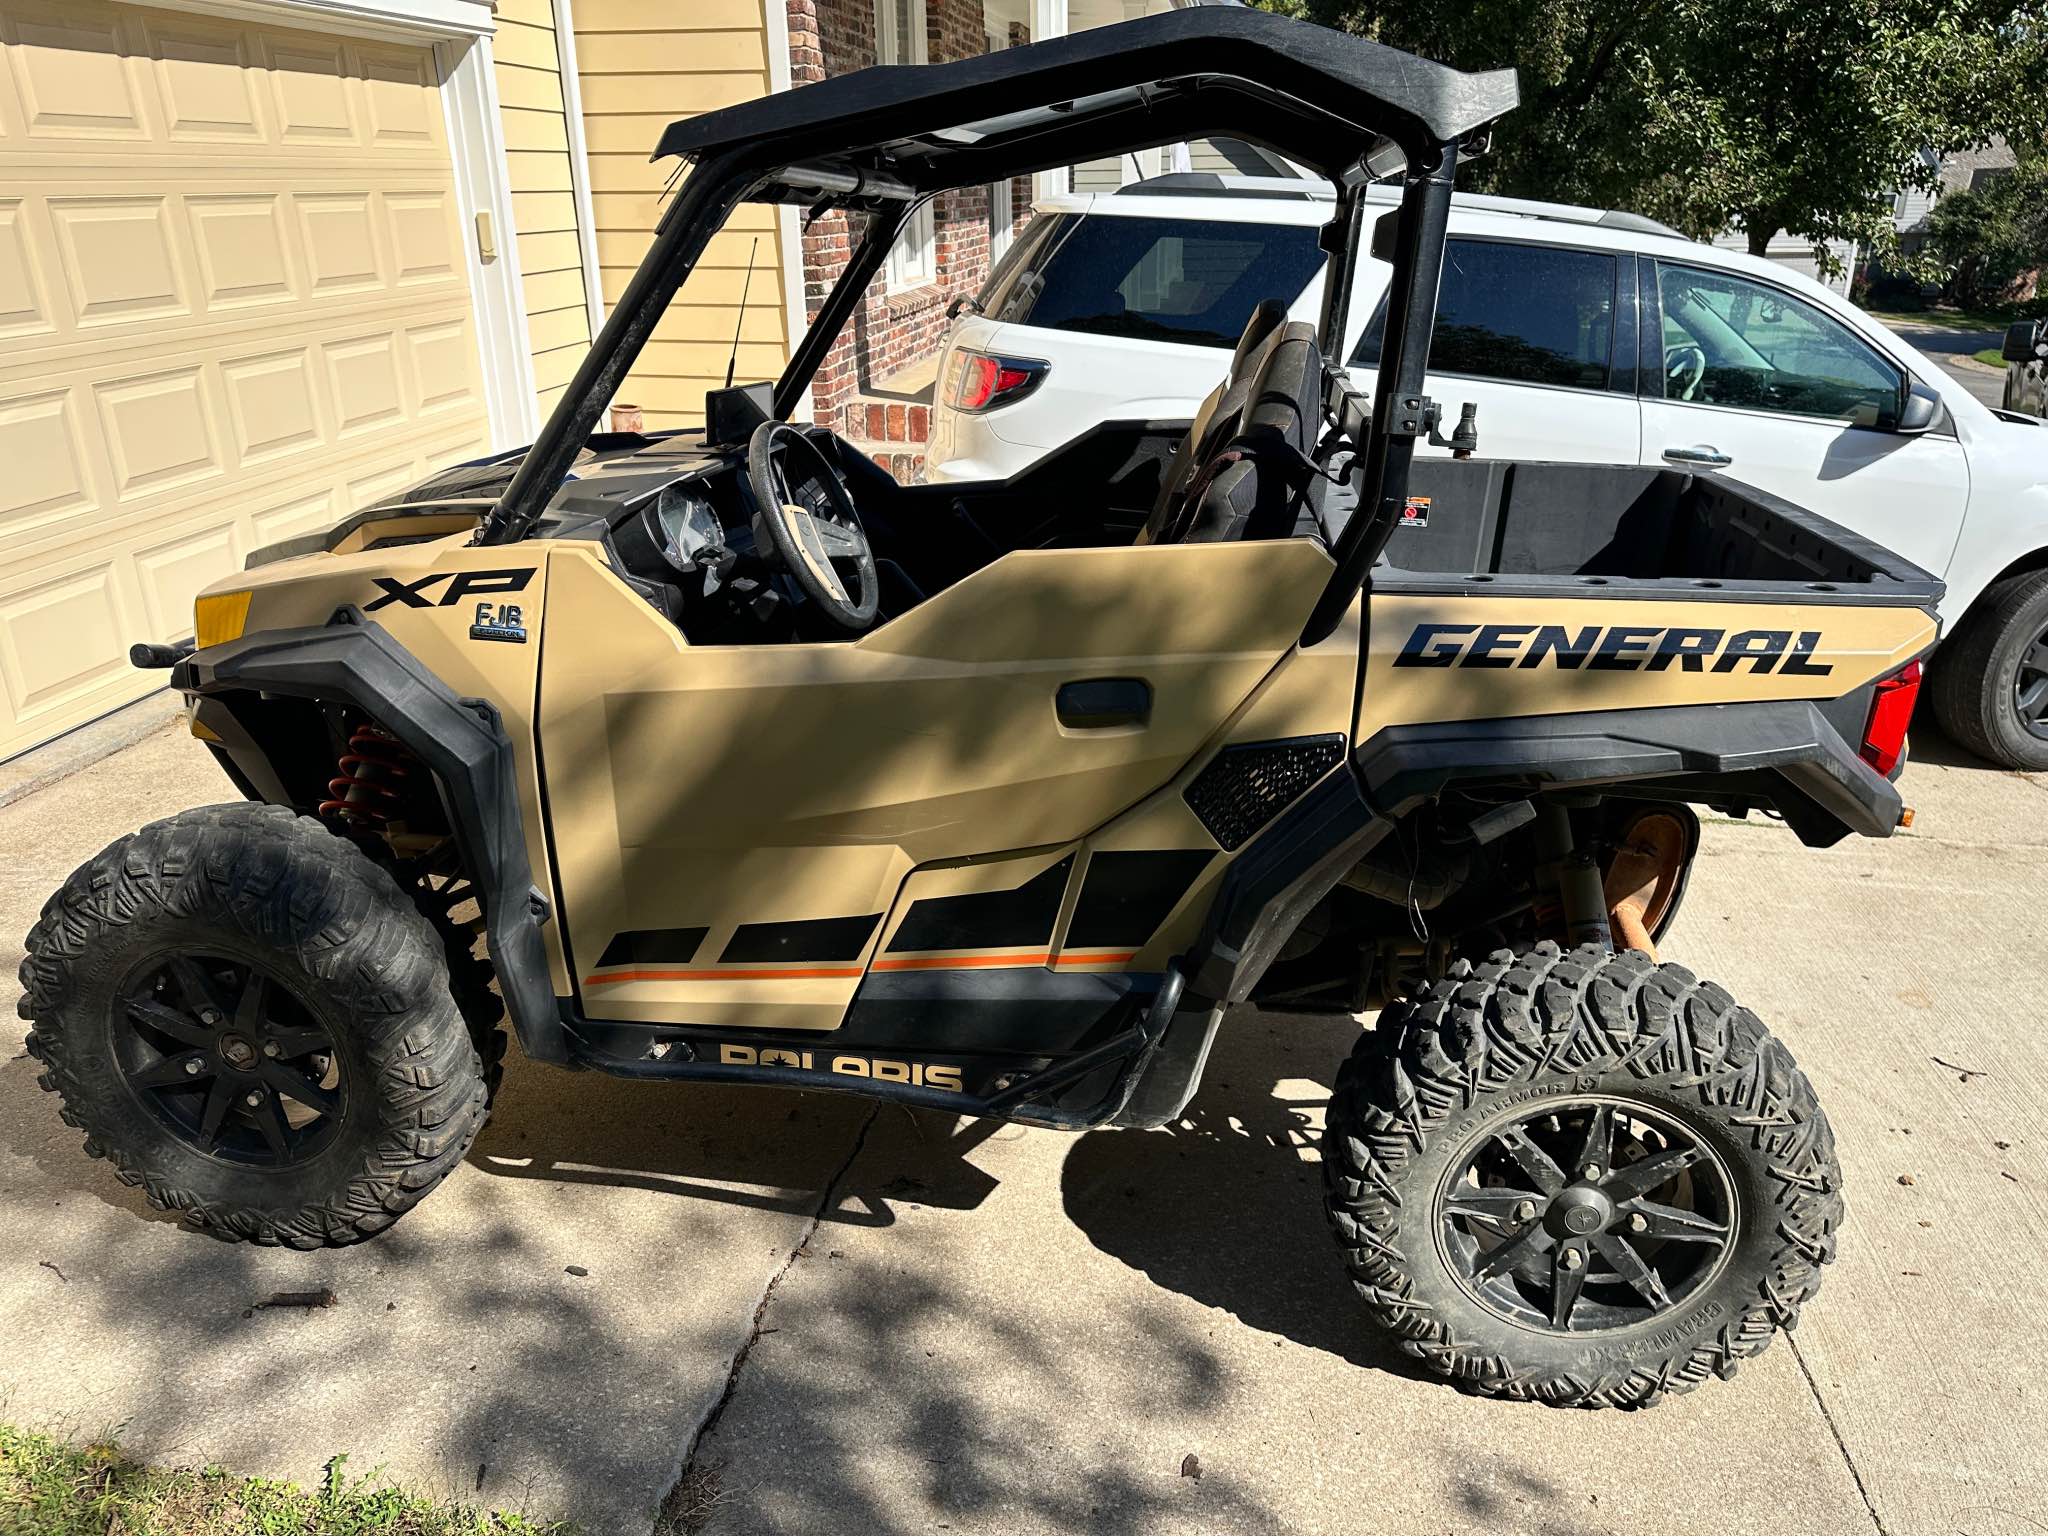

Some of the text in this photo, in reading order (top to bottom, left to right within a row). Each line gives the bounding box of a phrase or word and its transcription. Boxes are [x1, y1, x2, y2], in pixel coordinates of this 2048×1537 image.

[362, 567, 538, 612] XP
[475, 602, 522, 627] FJB
[1391, 623, 1834, 676] GENERAL
